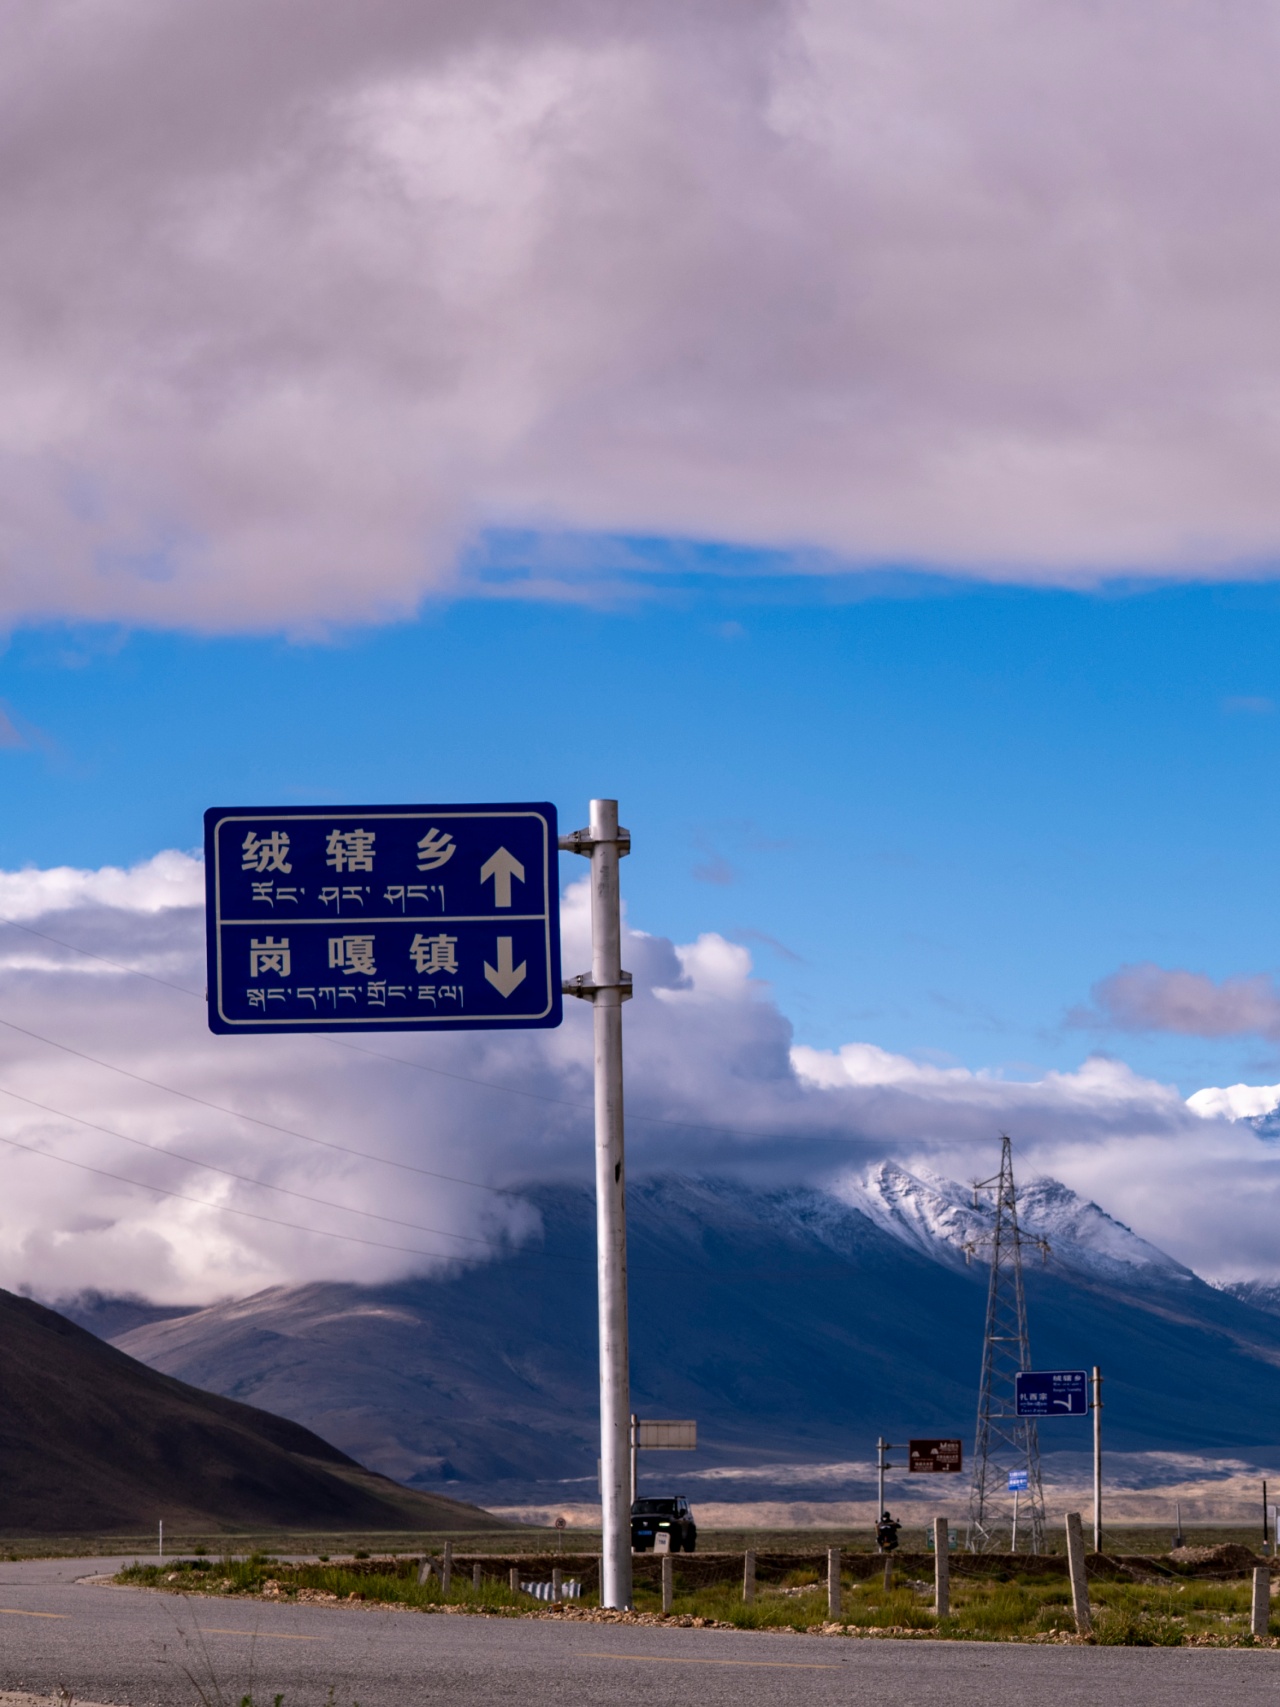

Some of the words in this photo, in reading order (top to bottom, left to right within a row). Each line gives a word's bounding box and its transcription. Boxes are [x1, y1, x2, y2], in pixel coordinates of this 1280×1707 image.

[242, 828, 456, 873] 绒辖乡
[250, 934, 459, 977] 岗嘎镇
